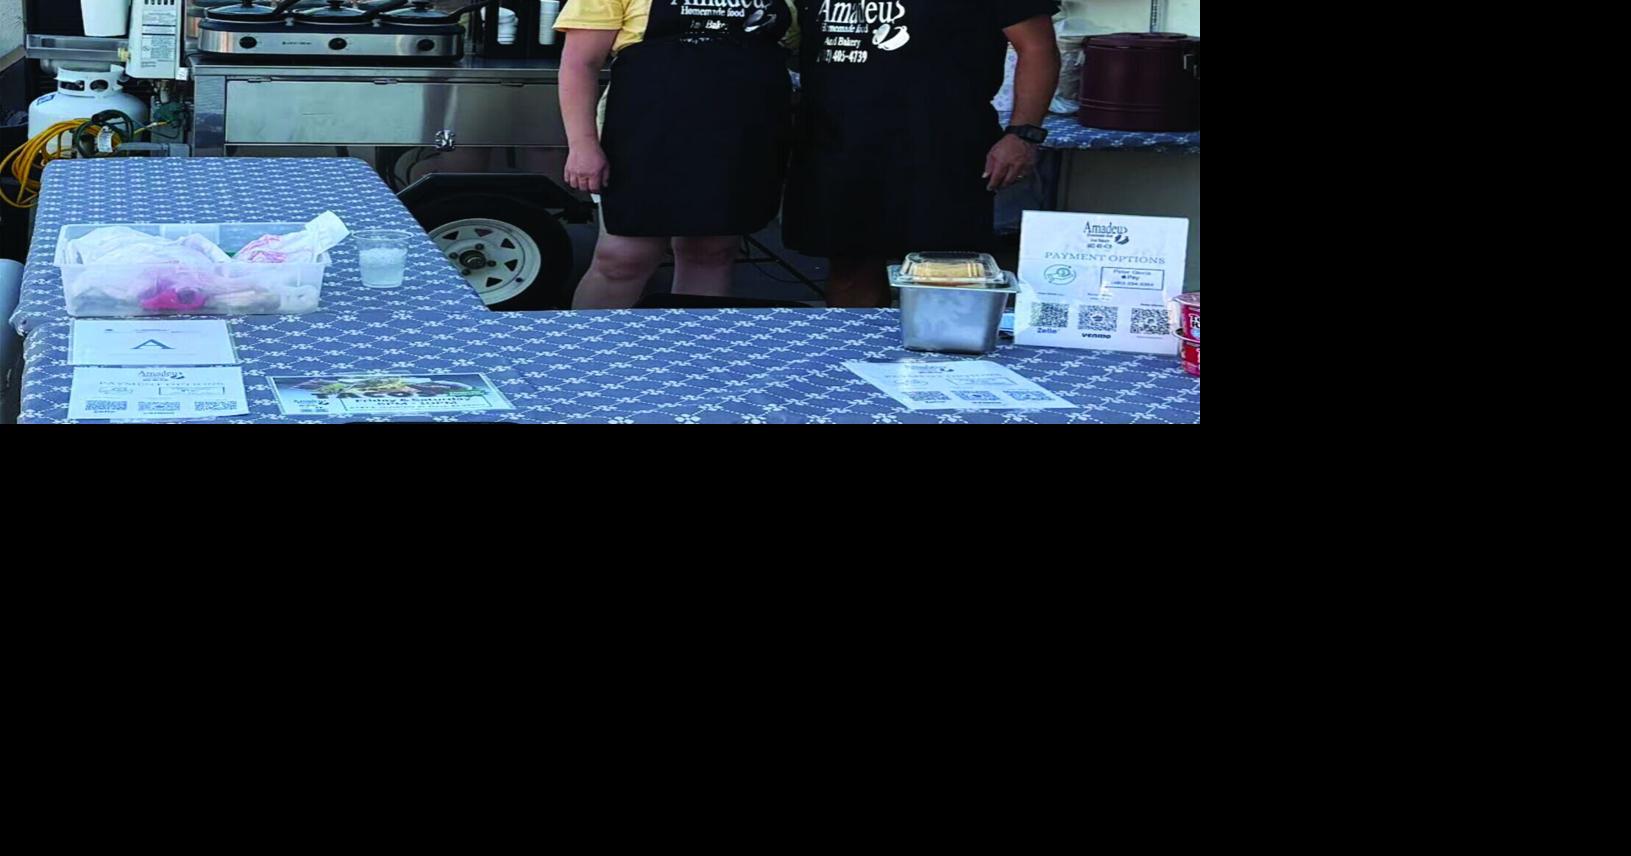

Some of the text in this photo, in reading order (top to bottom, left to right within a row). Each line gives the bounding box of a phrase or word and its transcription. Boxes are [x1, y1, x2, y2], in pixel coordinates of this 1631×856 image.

[681, 6, 745, 17] Homemade food
[837, 36, 861, 49] Bakery
[1044, 251, 1166, 264] PAYMENT OPTIONS
[130, 338, 176, 350] A
